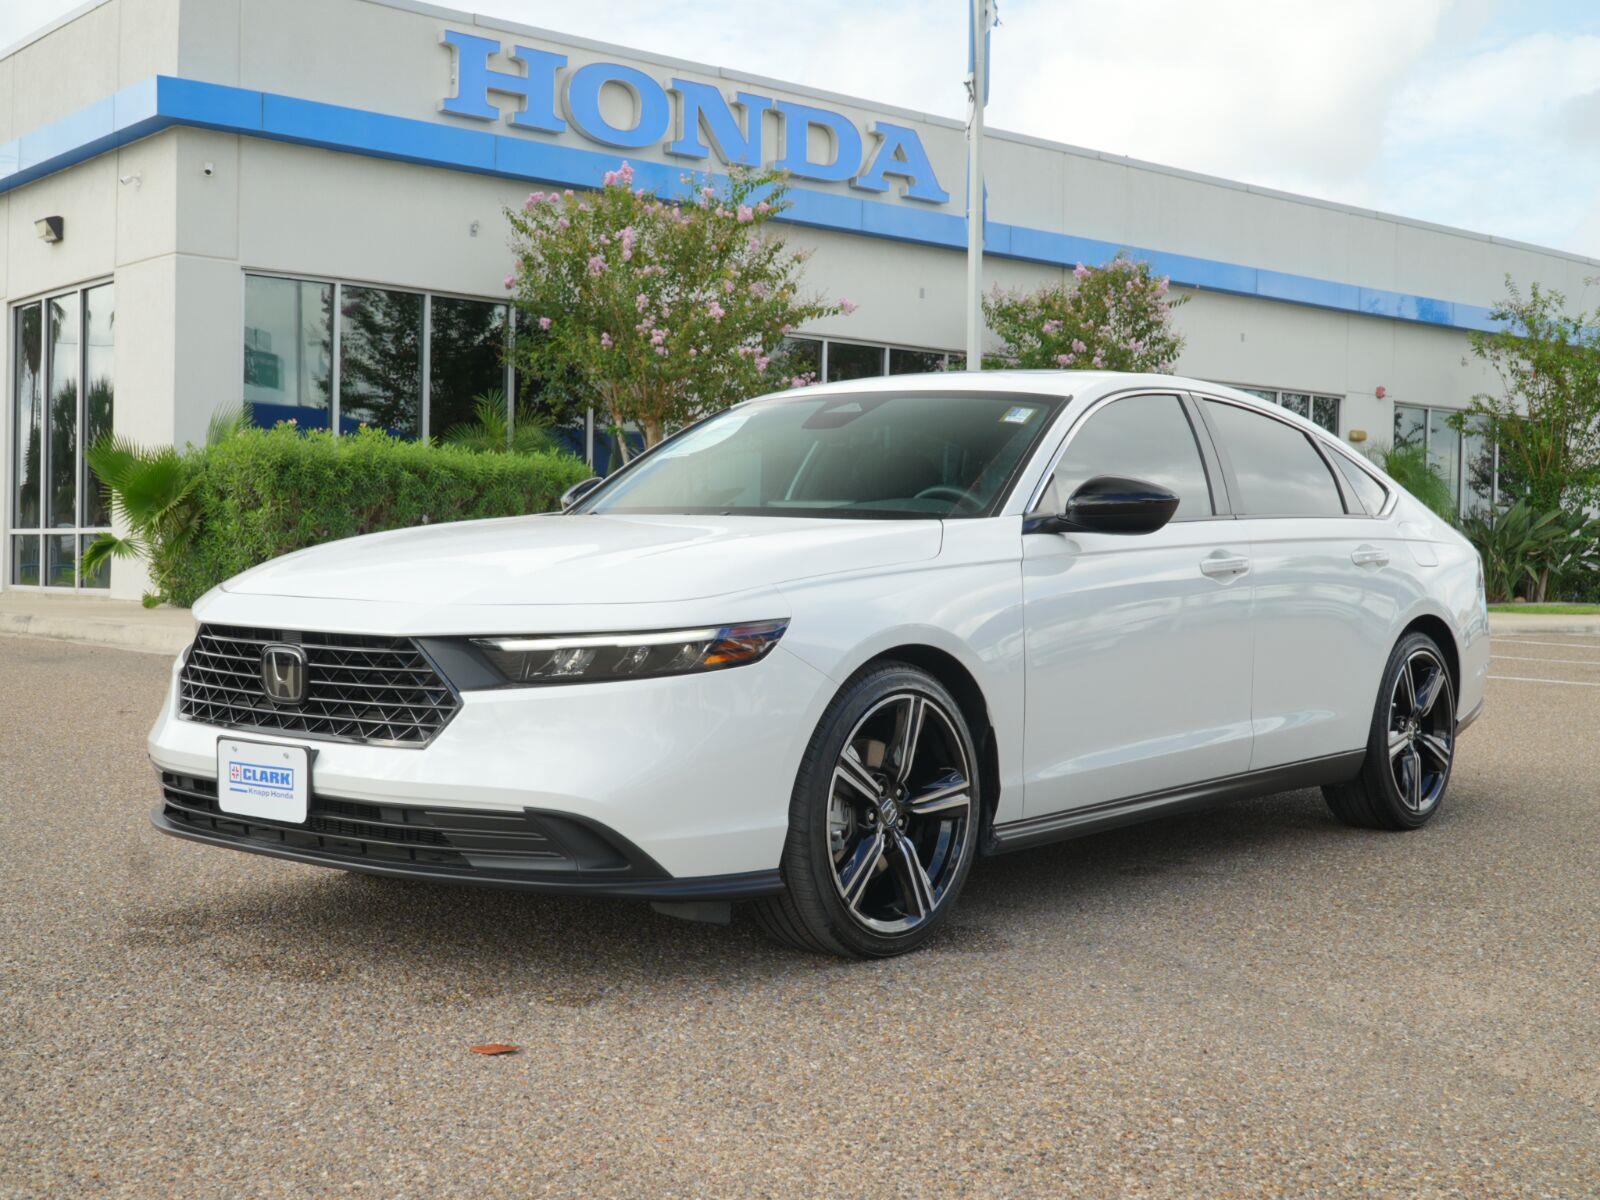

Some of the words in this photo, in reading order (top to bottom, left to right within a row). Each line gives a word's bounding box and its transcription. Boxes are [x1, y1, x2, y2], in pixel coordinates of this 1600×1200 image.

[438, 30, 950, 204] HONDA
[243, 768, 290, 785] CLARK
[248, 788, 270, 799] Knapp
[270, 790, 294, 799] Honda
